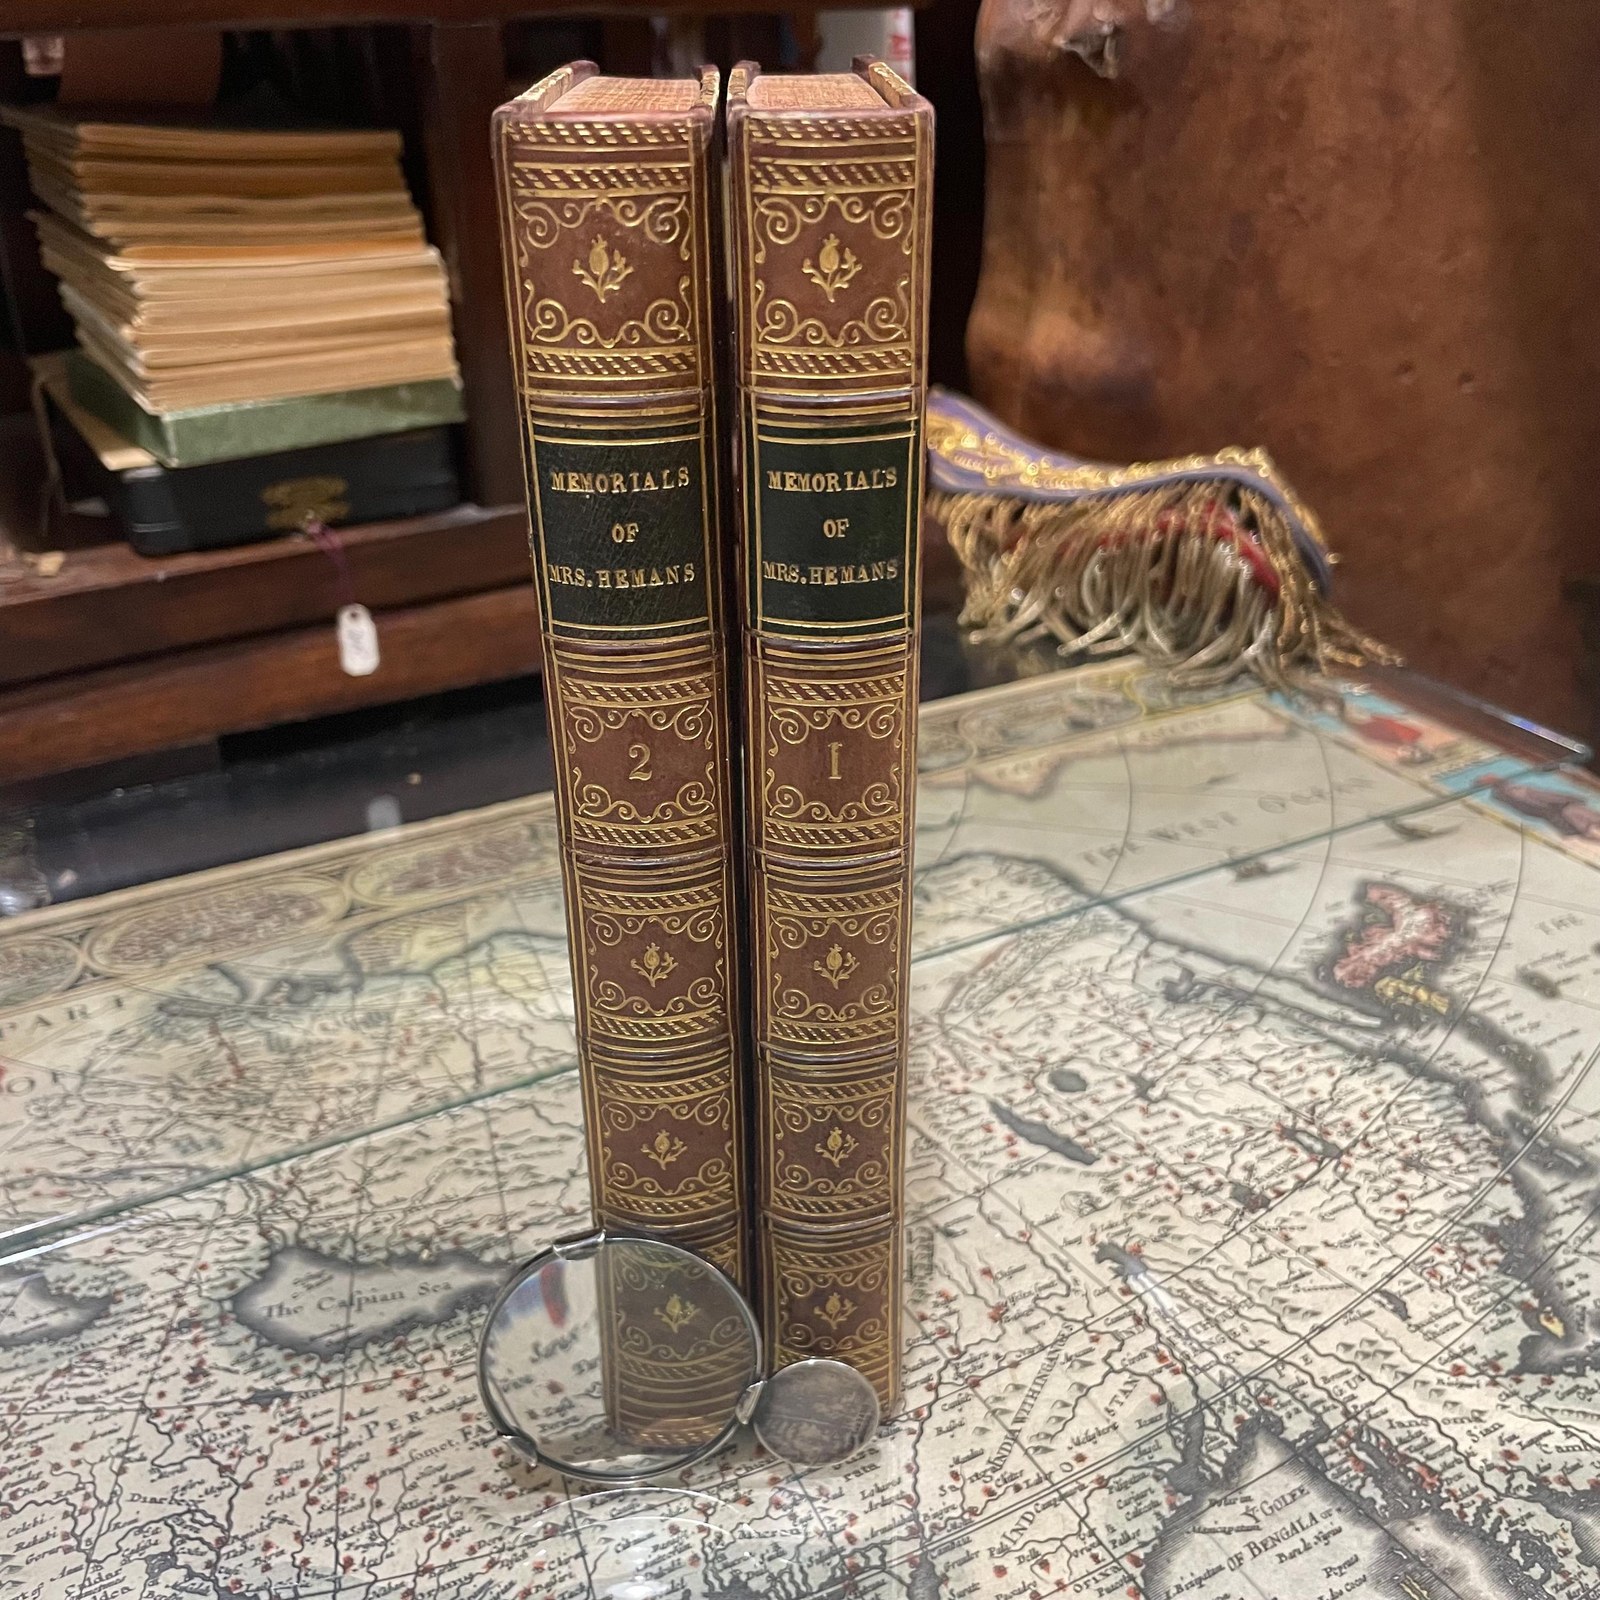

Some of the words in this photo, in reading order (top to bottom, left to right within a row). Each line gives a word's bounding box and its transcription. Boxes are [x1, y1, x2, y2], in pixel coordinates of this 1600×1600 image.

[551, 466, 690, 493] MEMORIALS
[767, 466, 899, 492] MEMORIALS
[611, 522, 640, 543] OF
[823, 518, 850, 539] OF
[628, 743, 653, 782] 2
